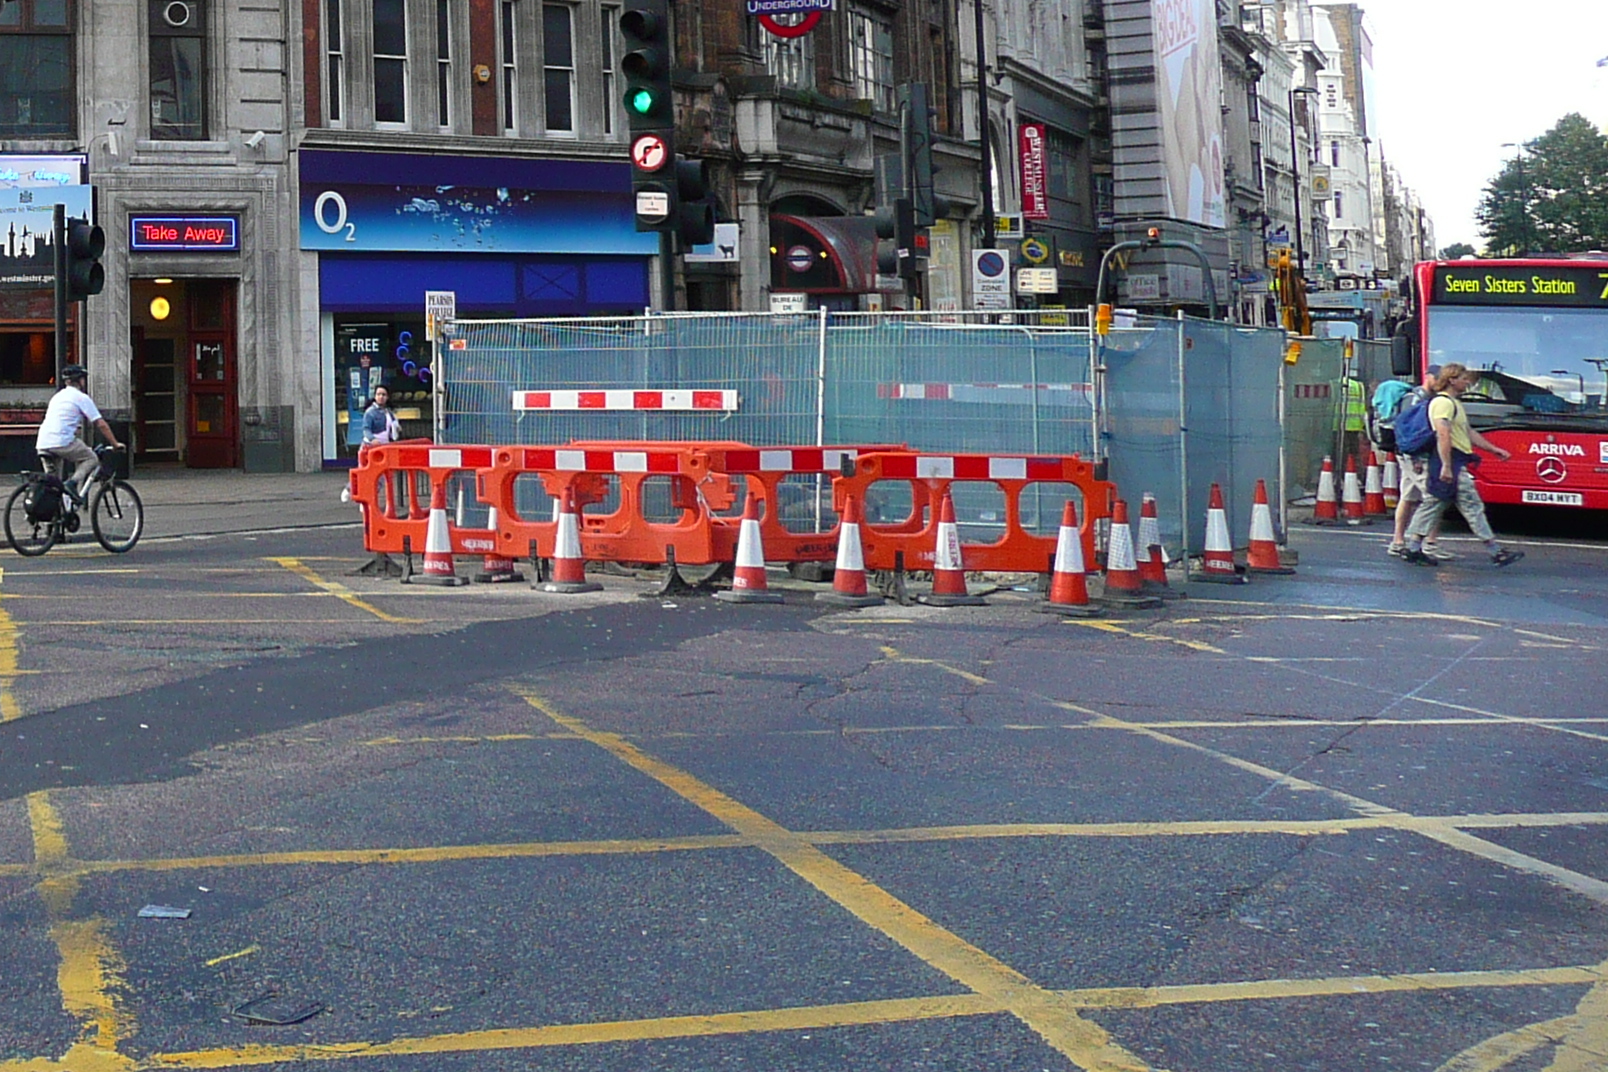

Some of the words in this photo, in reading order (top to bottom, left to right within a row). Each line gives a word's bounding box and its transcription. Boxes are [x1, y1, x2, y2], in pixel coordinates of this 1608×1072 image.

[1023, 153, 1034, 196] COLLEGE
[1030, 136, 1047, 213] WESTMINSTER
[314, 190, 356, 242] O2
[142, 225, 178, 241] Take
[184, 226, 225, 244] Away
[1445, 274, 1480, 293] Seven
[1484, 275, 1527, 294] Sisters
[1531, 275, 1576, 295] Station
[428, 295, 454, 306] PEARSON
[771, 296, 803, 304] BUREAU
[350, 338, 380, 353] FREE
[1528, 442, 1586, 457] ARRIVA
